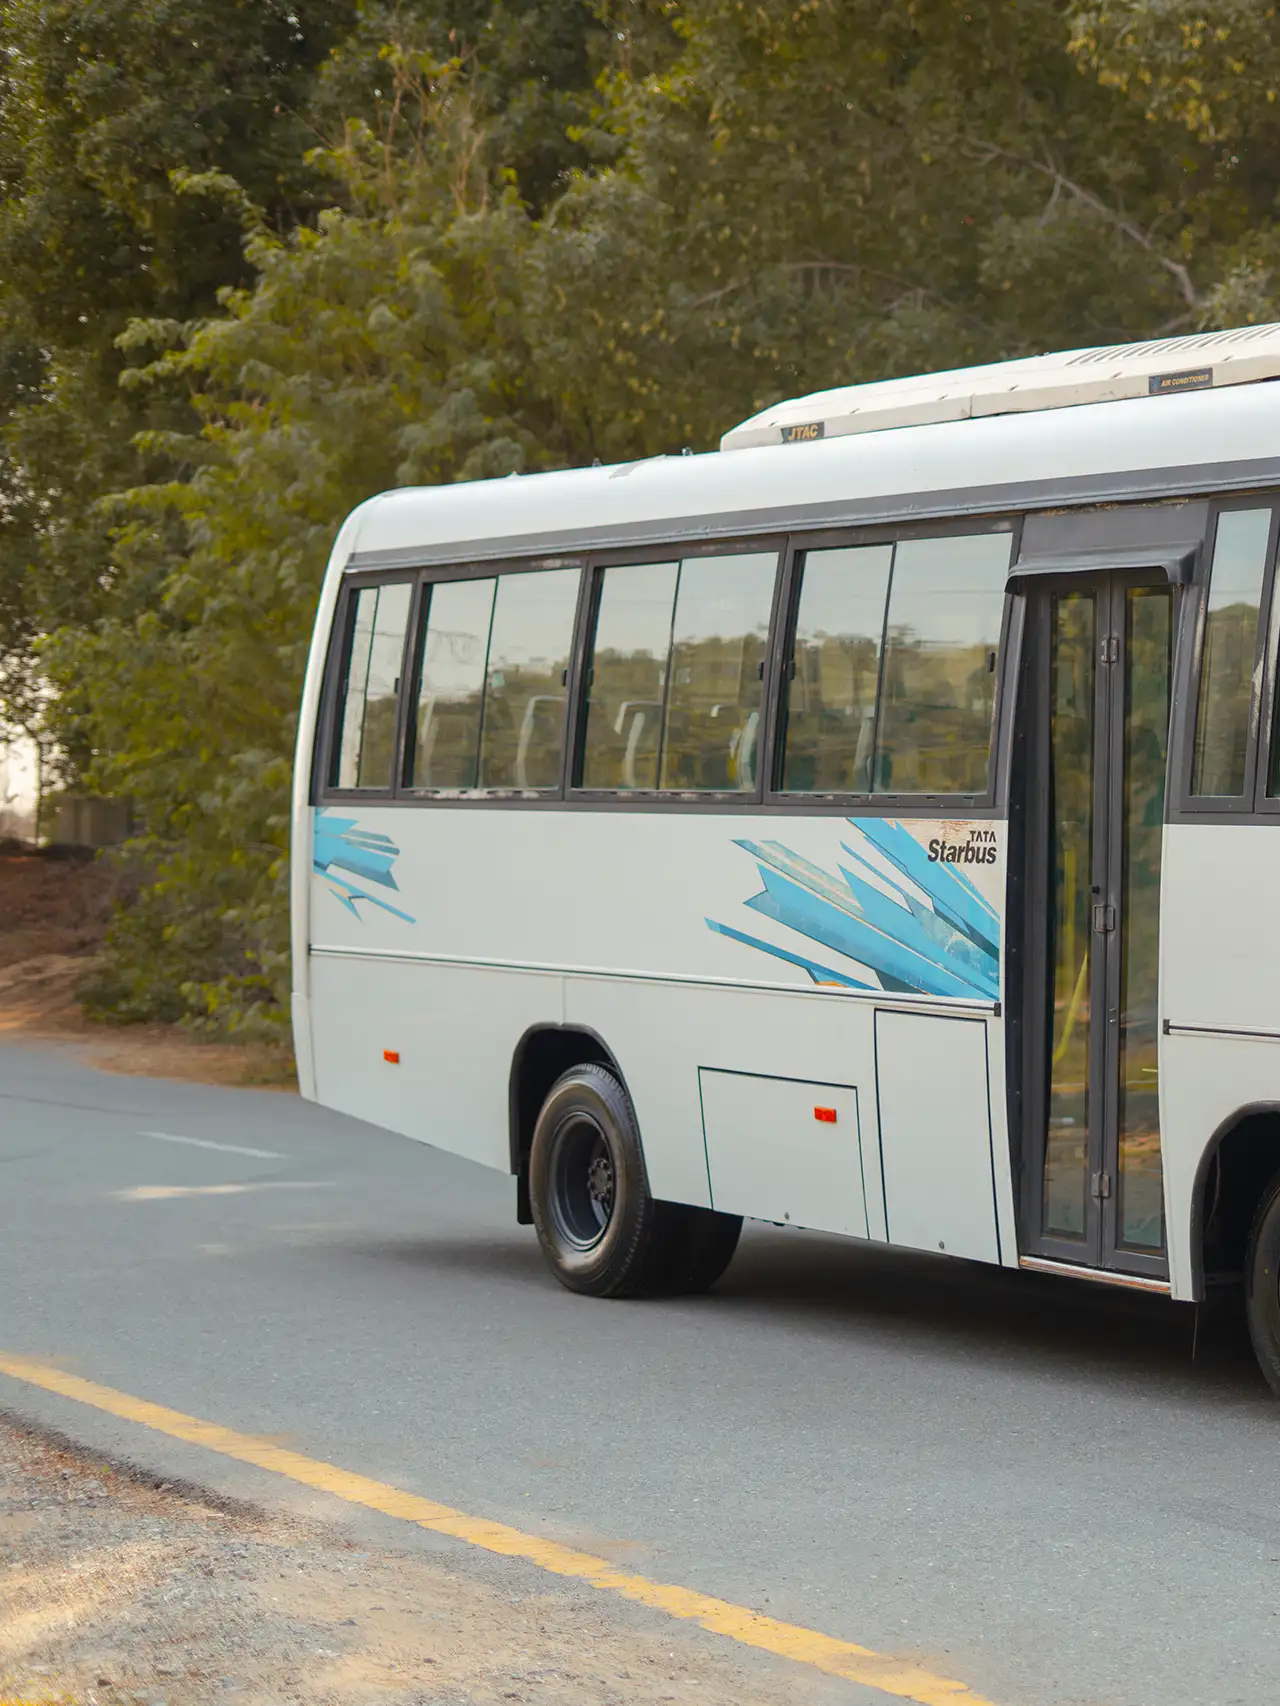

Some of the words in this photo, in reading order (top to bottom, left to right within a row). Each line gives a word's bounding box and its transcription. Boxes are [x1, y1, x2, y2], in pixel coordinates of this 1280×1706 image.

[787, 424, 818, 441] JTAC
[970, 831, 996, 843] TATA
[928, 839, 997, 864] Starbus
